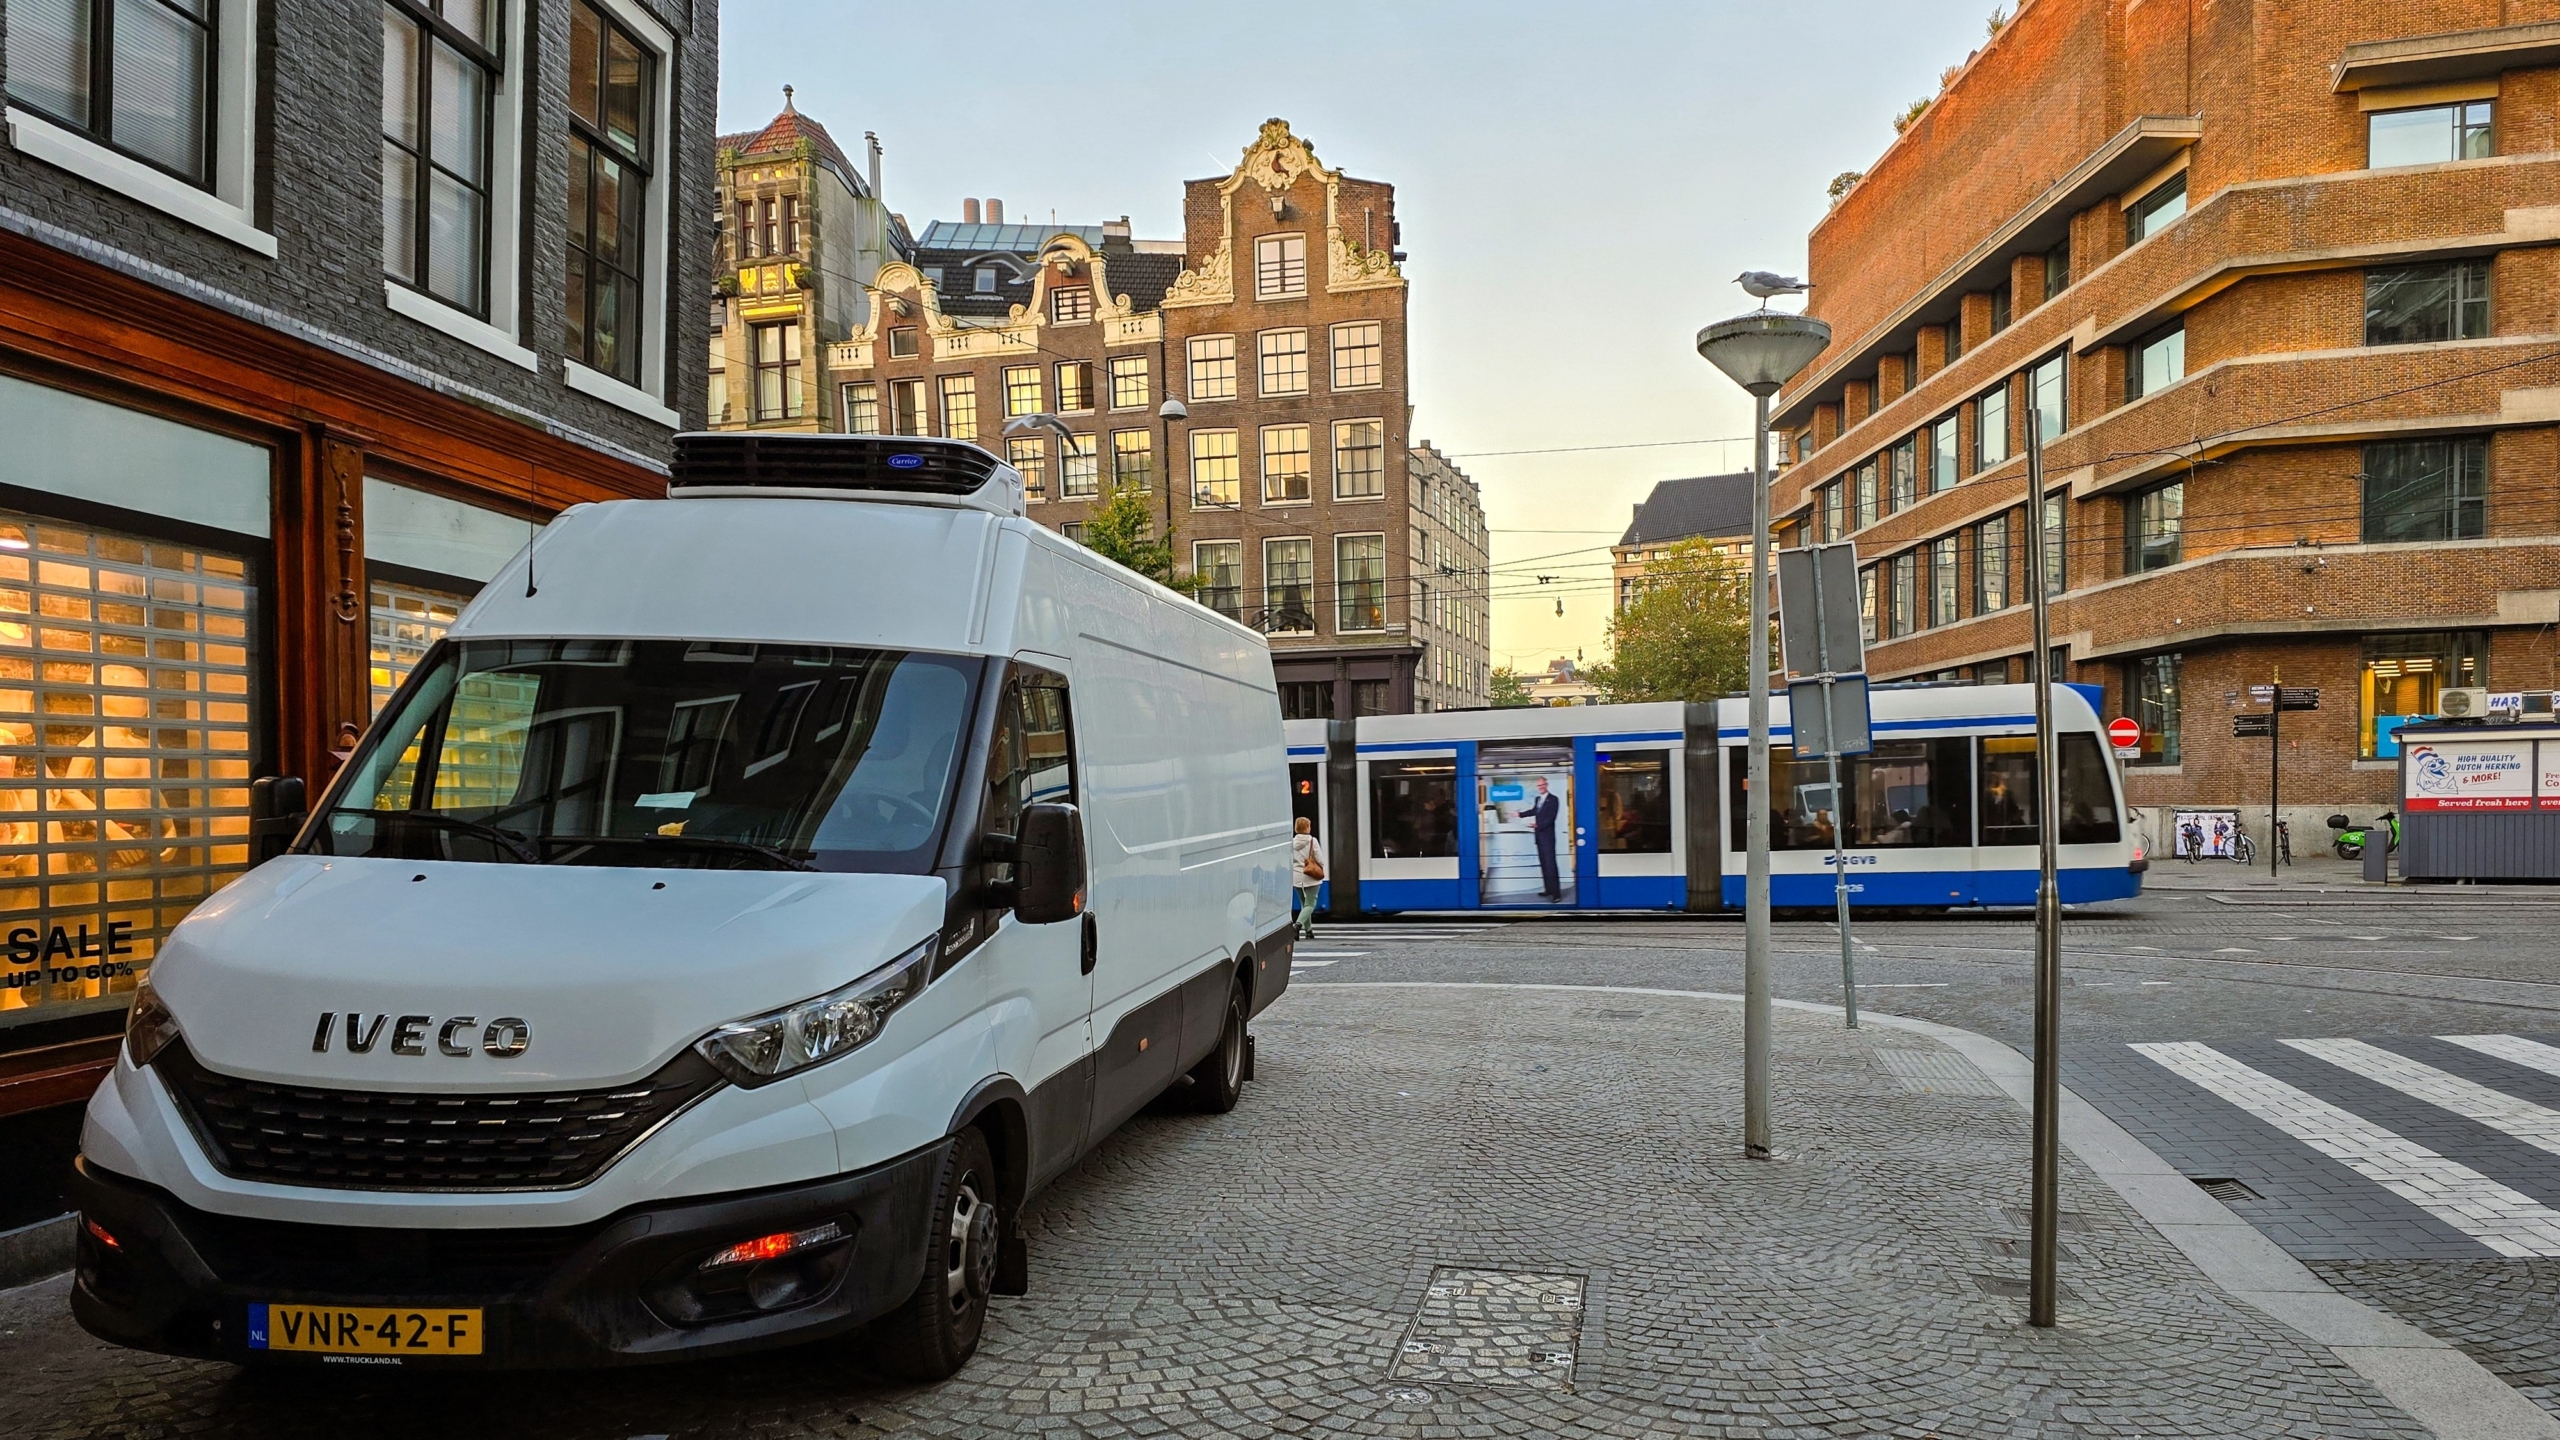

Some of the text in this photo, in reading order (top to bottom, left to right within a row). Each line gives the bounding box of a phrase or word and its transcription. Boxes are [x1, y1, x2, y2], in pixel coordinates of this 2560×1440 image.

[1301, 780, 1310, 794] 2
[2471, 772, 2501, 783] MORE!
[1850, 856, 1877, 864] GVB
[8, 921, 133, 964] SALE
[8, 961, 133, 988] UP TO 60%
[311, 1011, 533, 1059] IVECO
[251, 1310, 468, 1348] NL VNR-42-F
[323, 1355, 402, 1365] WWW.TRUCKLAND.NL
